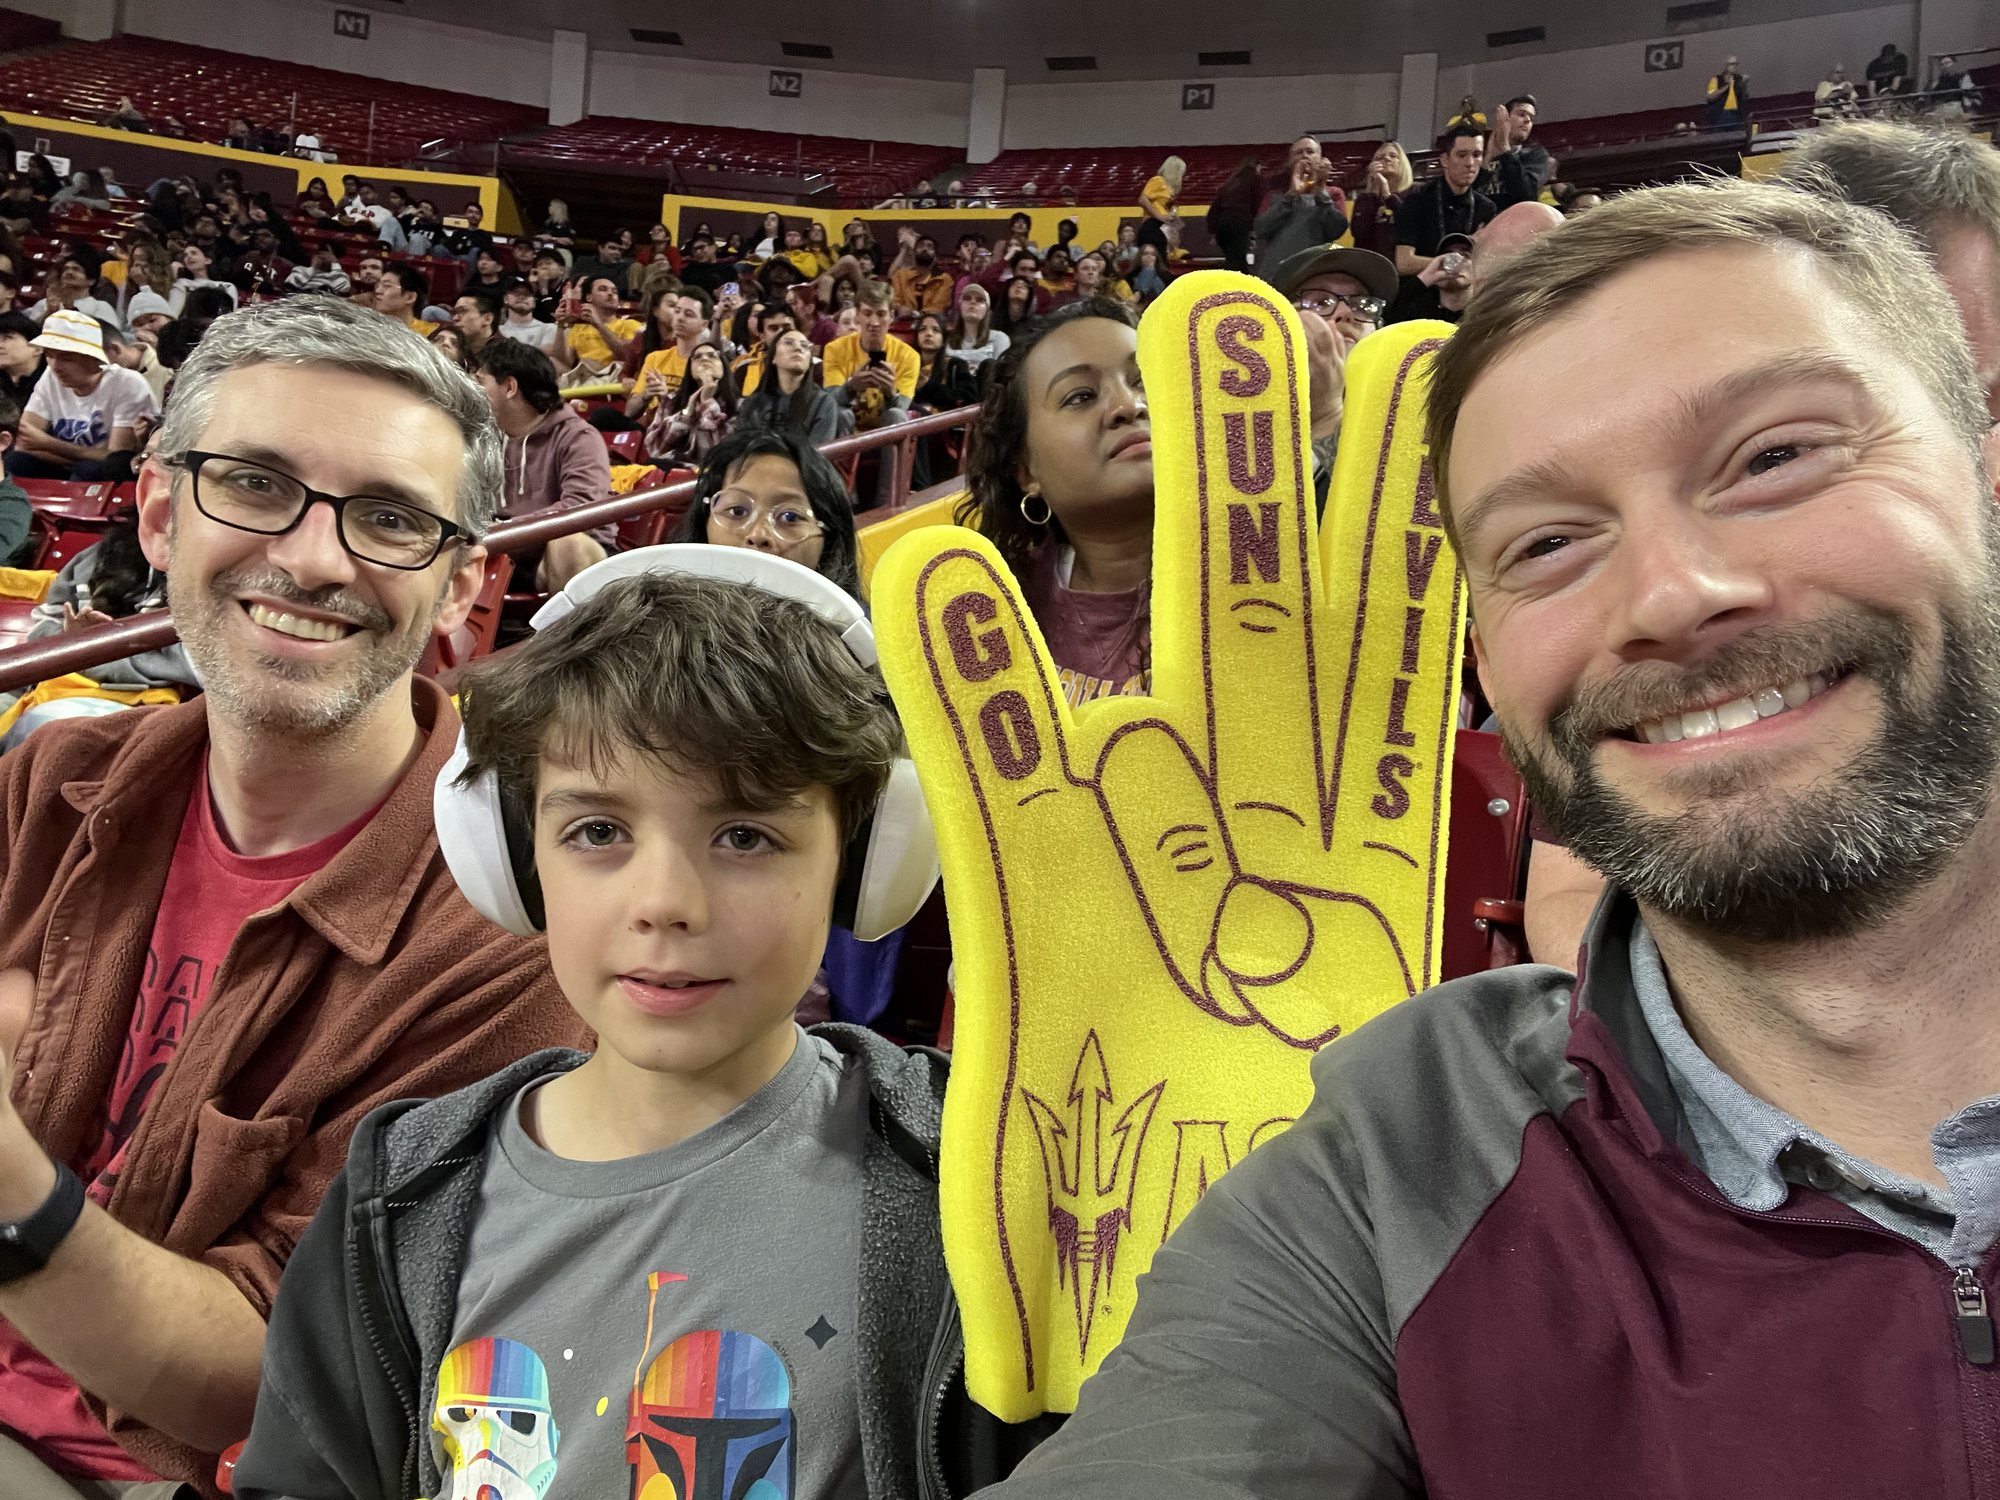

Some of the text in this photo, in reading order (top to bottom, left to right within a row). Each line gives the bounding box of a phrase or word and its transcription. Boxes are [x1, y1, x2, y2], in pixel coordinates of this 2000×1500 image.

[338, 14, 366, 34] N1
[1650, 46, 1680, 69] Q1
[772, 74, 799, 92] N2
[1187, 88, 1210, 105] P1
[941, 591, 1042, 781] GO
[1215, 314, 1282, 584] SUN
